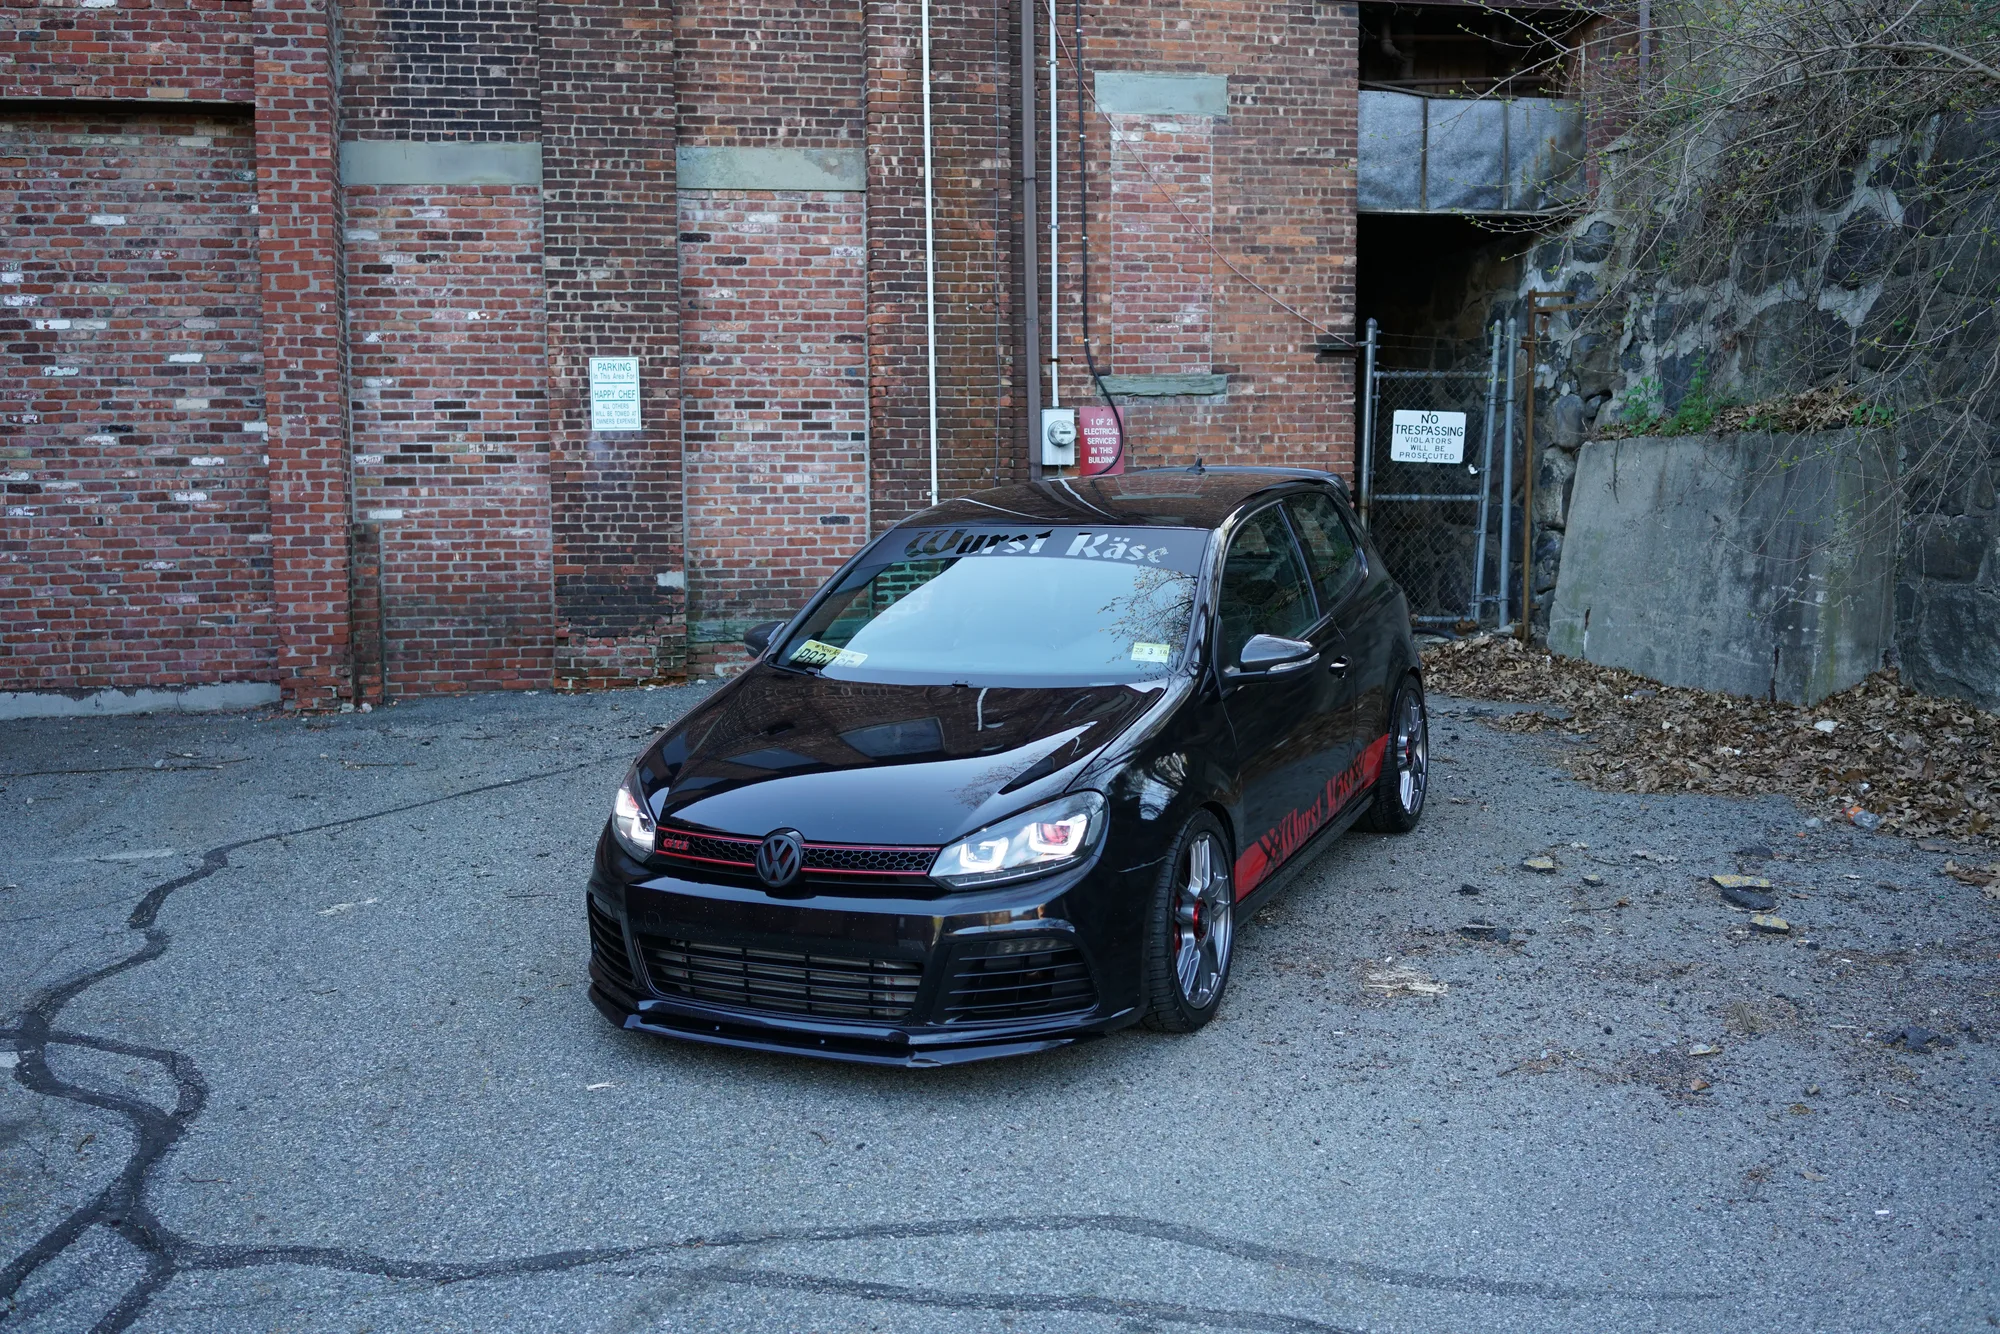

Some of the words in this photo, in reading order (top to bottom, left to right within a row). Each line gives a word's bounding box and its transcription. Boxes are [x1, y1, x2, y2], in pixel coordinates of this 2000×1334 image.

[597, 362, 632, 371] PARKING
[594, 390, 616, 399] HAPPY
[618, 390, 636, 398] CHEF
[1421, 414, 1439, 424] NO
[1395, 424, 1463, 437] TRESPASSING
[1087, 437, 1116, 445] SERVICES
[1405, 436, 1452, 445] VIOLATORS
[1410, 444, 1428, 452] WILL
[1399, 451, 1455, 460] PROSECUTED
[904, 528, 1054, 558] Wurst
[1065, 532, 1169, 564] Käse
[663, 838, 690, 851] GTI
